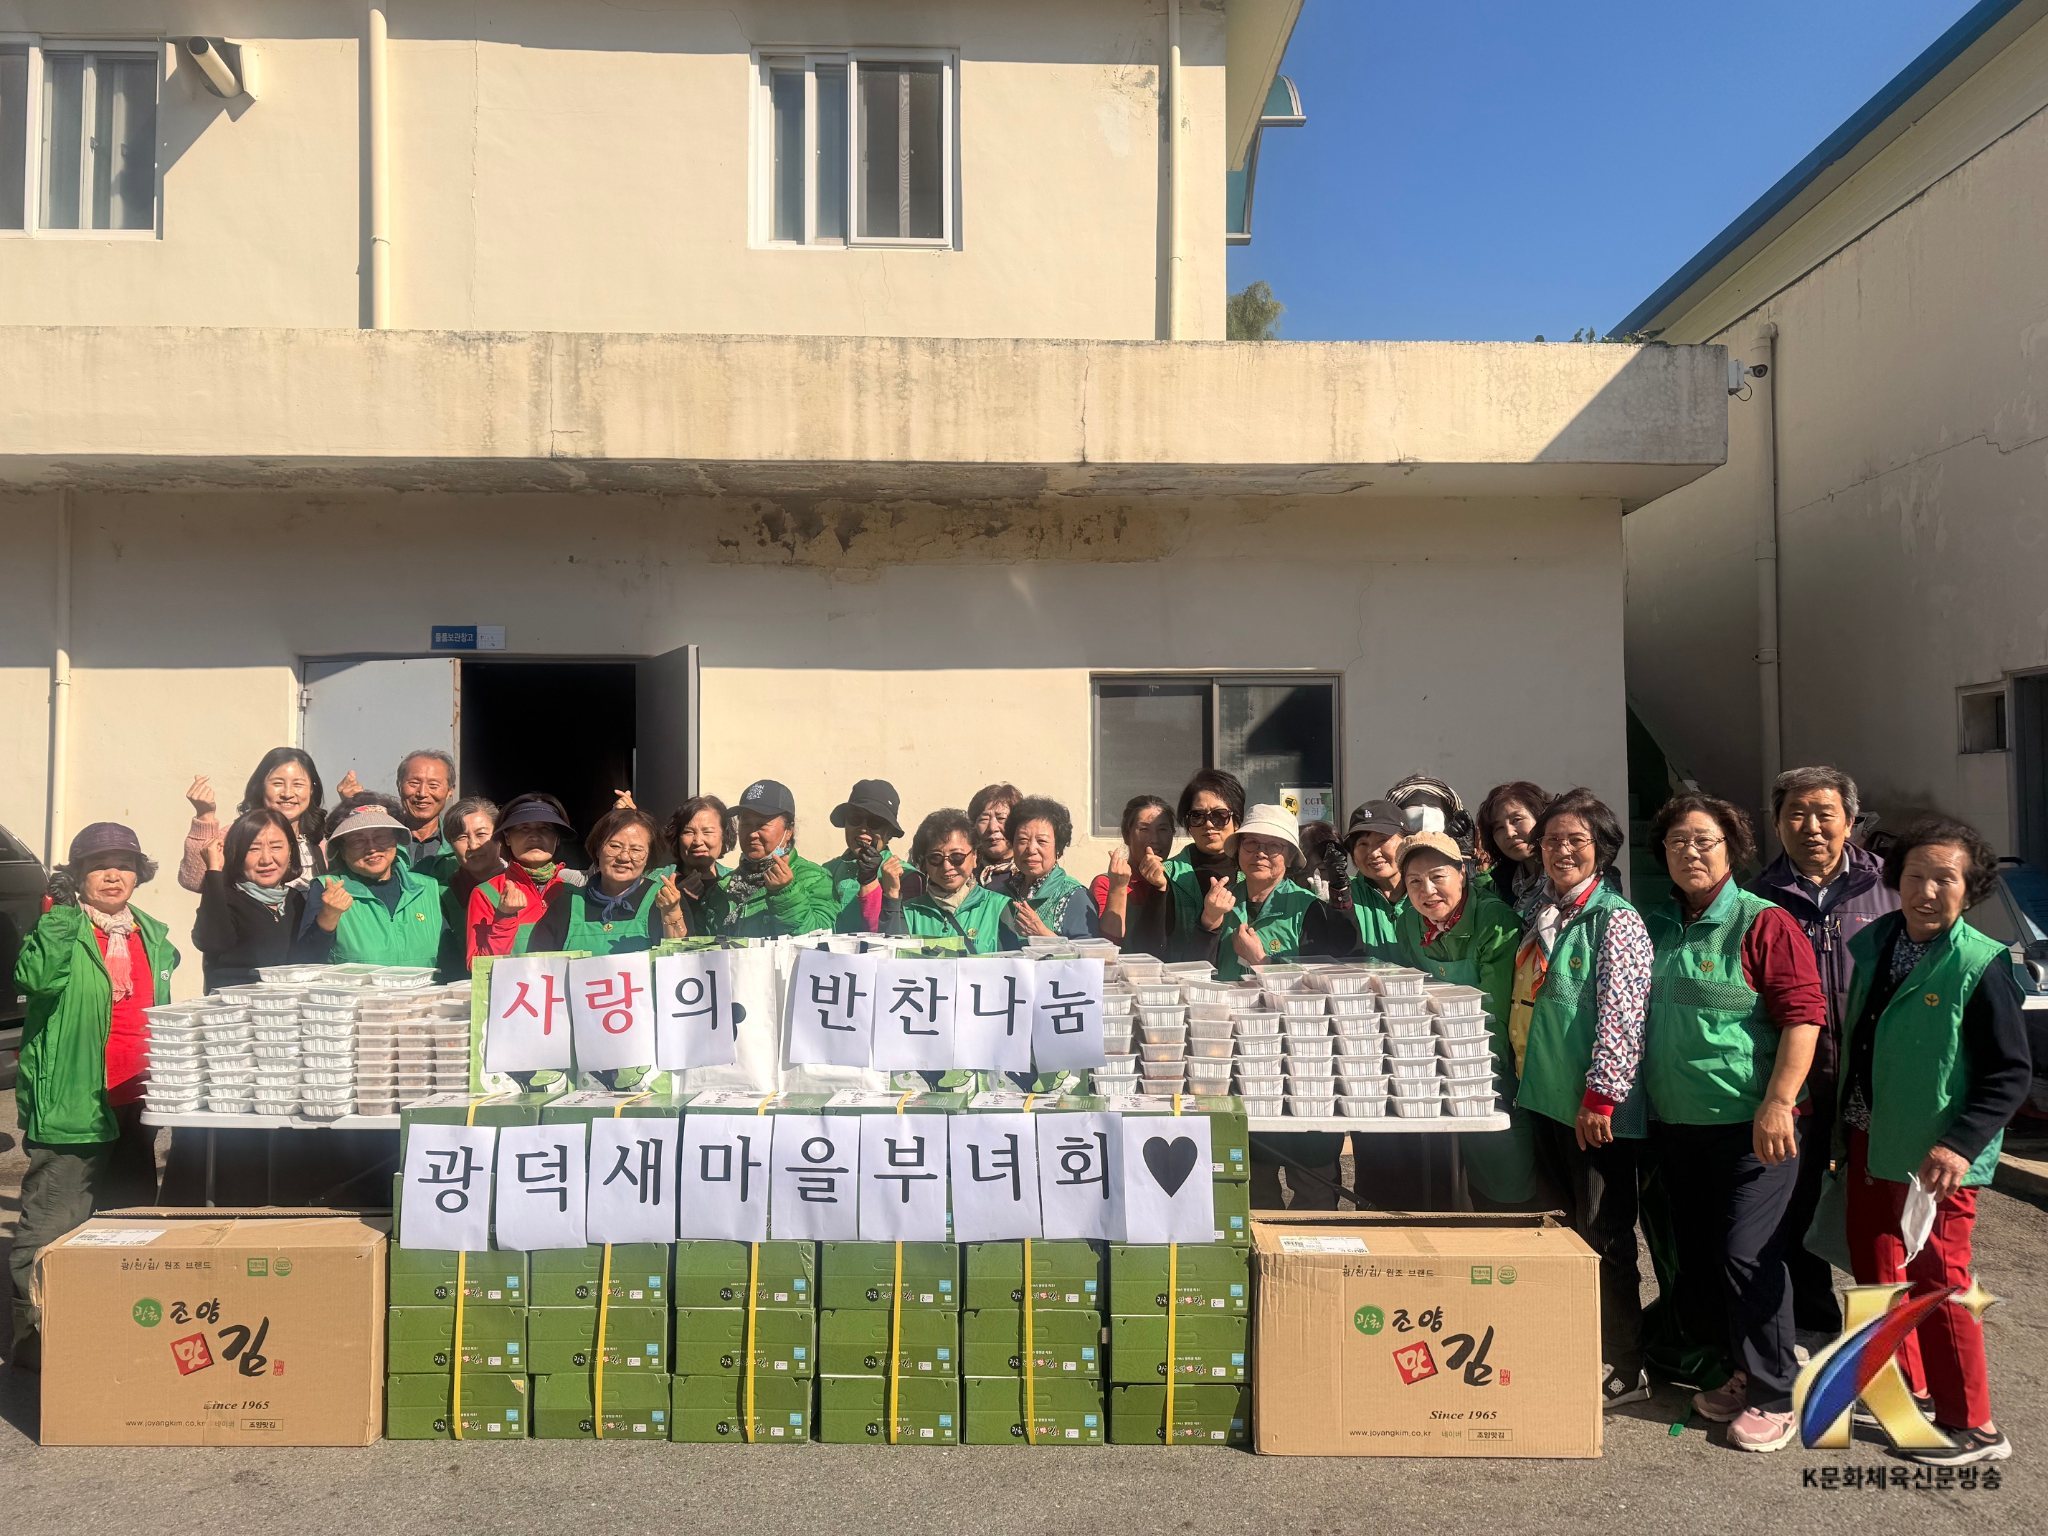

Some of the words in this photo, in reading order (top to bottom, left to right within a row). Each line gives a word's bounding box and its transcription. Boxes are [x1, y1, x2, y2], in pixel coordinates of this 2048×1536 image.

[502, 970, 718, 1035] 사랑의
[809, 971, 1096, 1036] 반찬나눔
[186, 1261, 212, 1270] 브랜드
[1408, 1268, 1434, 1277] 브랜드
[170, 1297, 221, 1325] 조양
[1392, 1306, 1443, 1333] 조양
[241, 1400, 270, 1410] 1965
[1429, 1410, 1464, 1420] Since
[1468, 1410, 1497, 1420] 1965
[1349, 1429, 1431, 1438] www.joyangkim.co.kr
